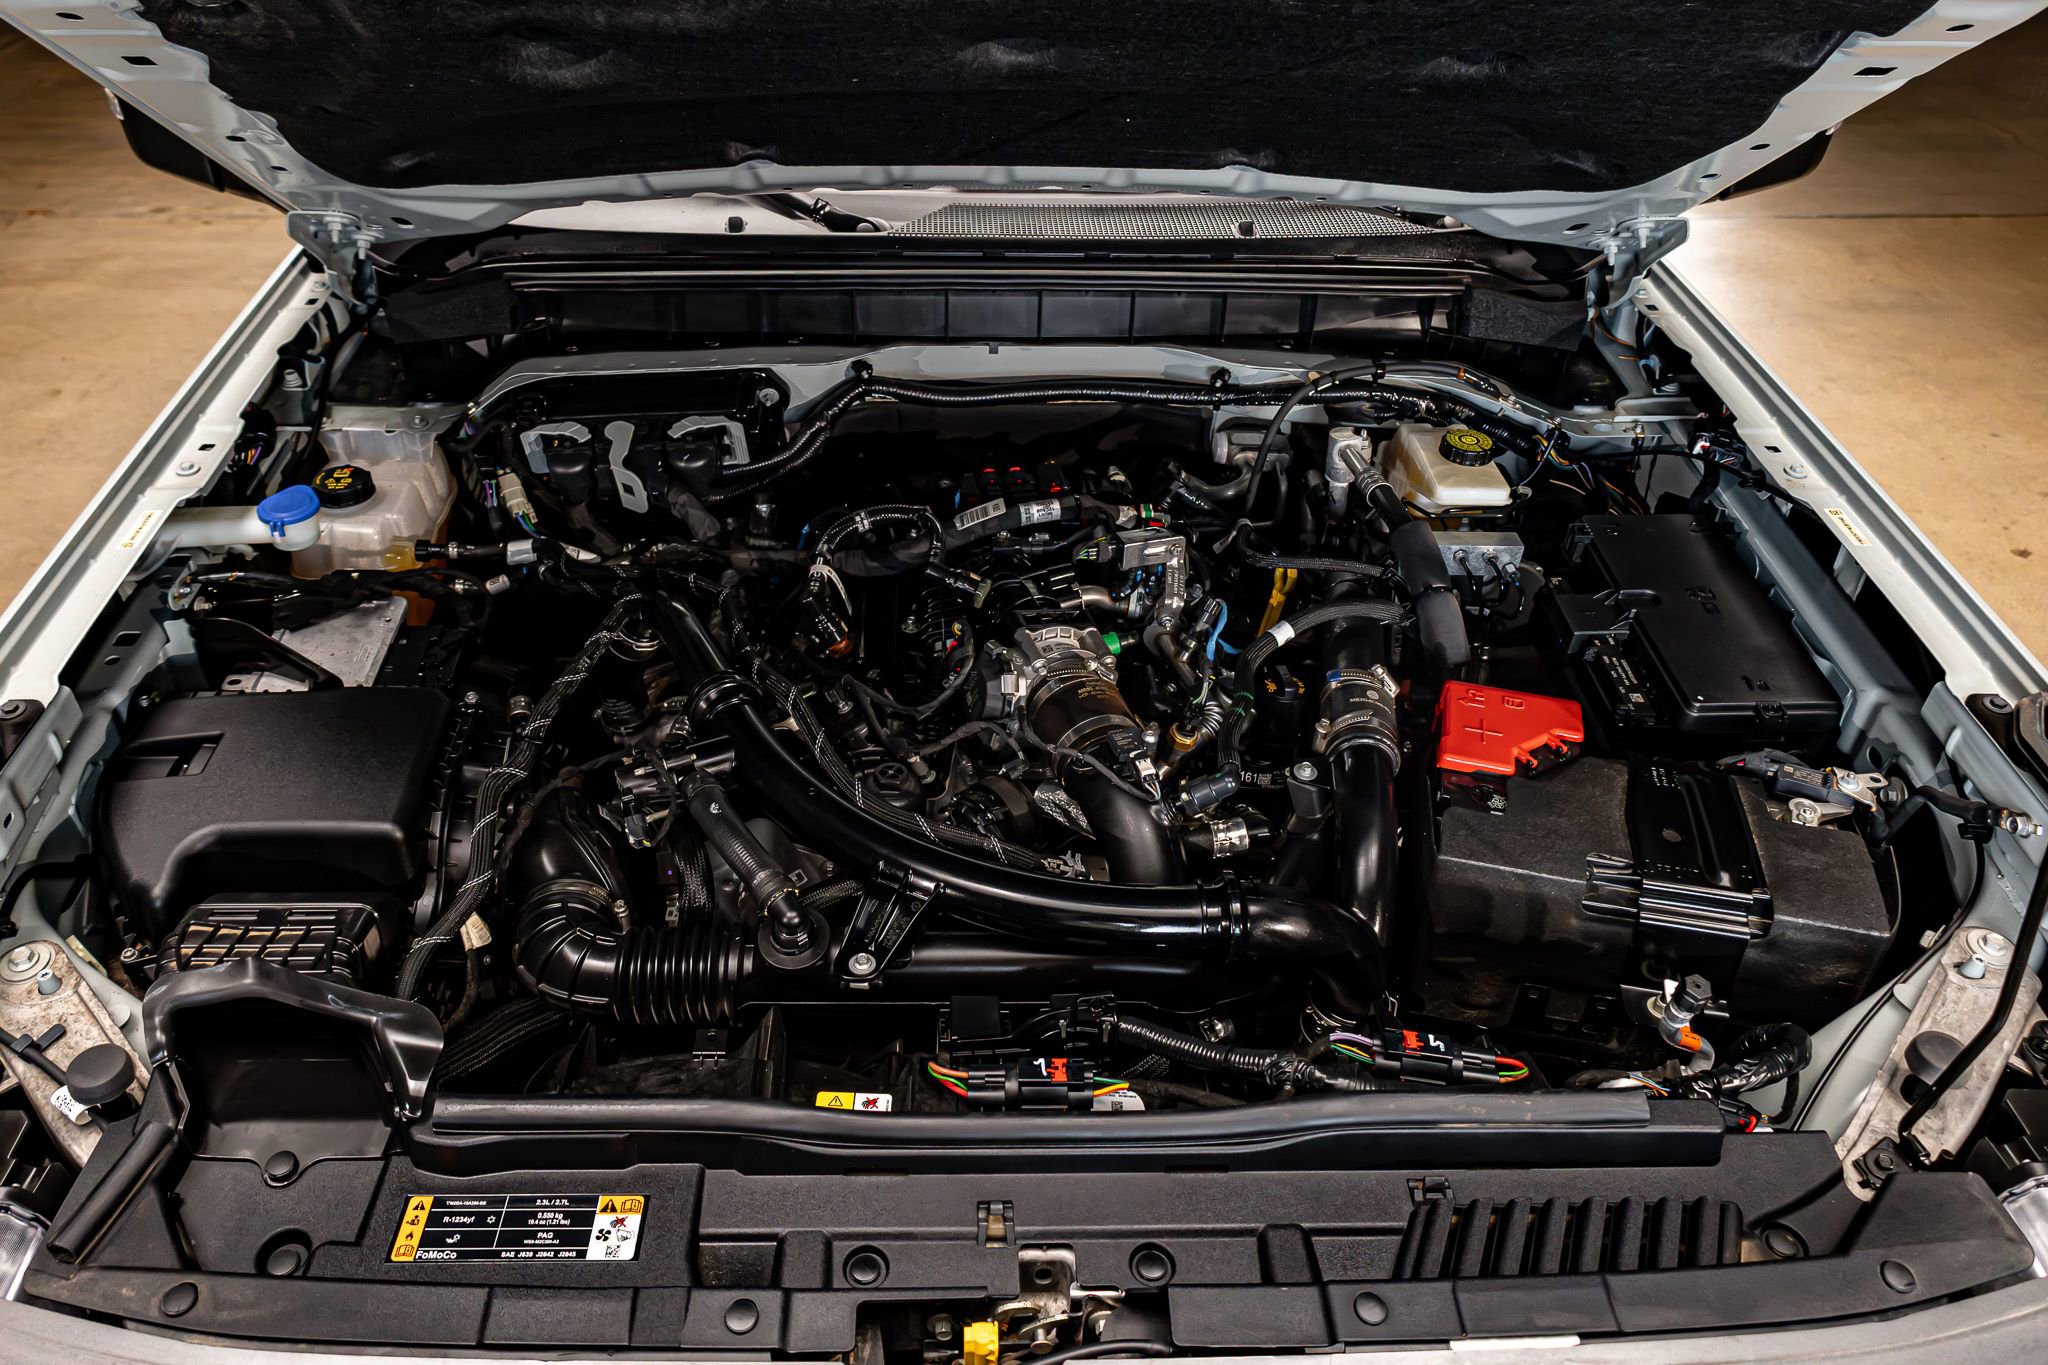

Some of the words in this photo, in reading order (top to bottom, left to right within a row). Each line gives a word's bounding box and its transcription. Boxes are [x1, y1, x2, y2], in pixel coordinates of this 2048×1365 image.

[1240, 771, 1257, 783] 161
[442, 1216, 476, 1224] R-1234yf
[555, 1212, 564, 1220] kg
[415, 1250, 457, 1260] FoMoCo
